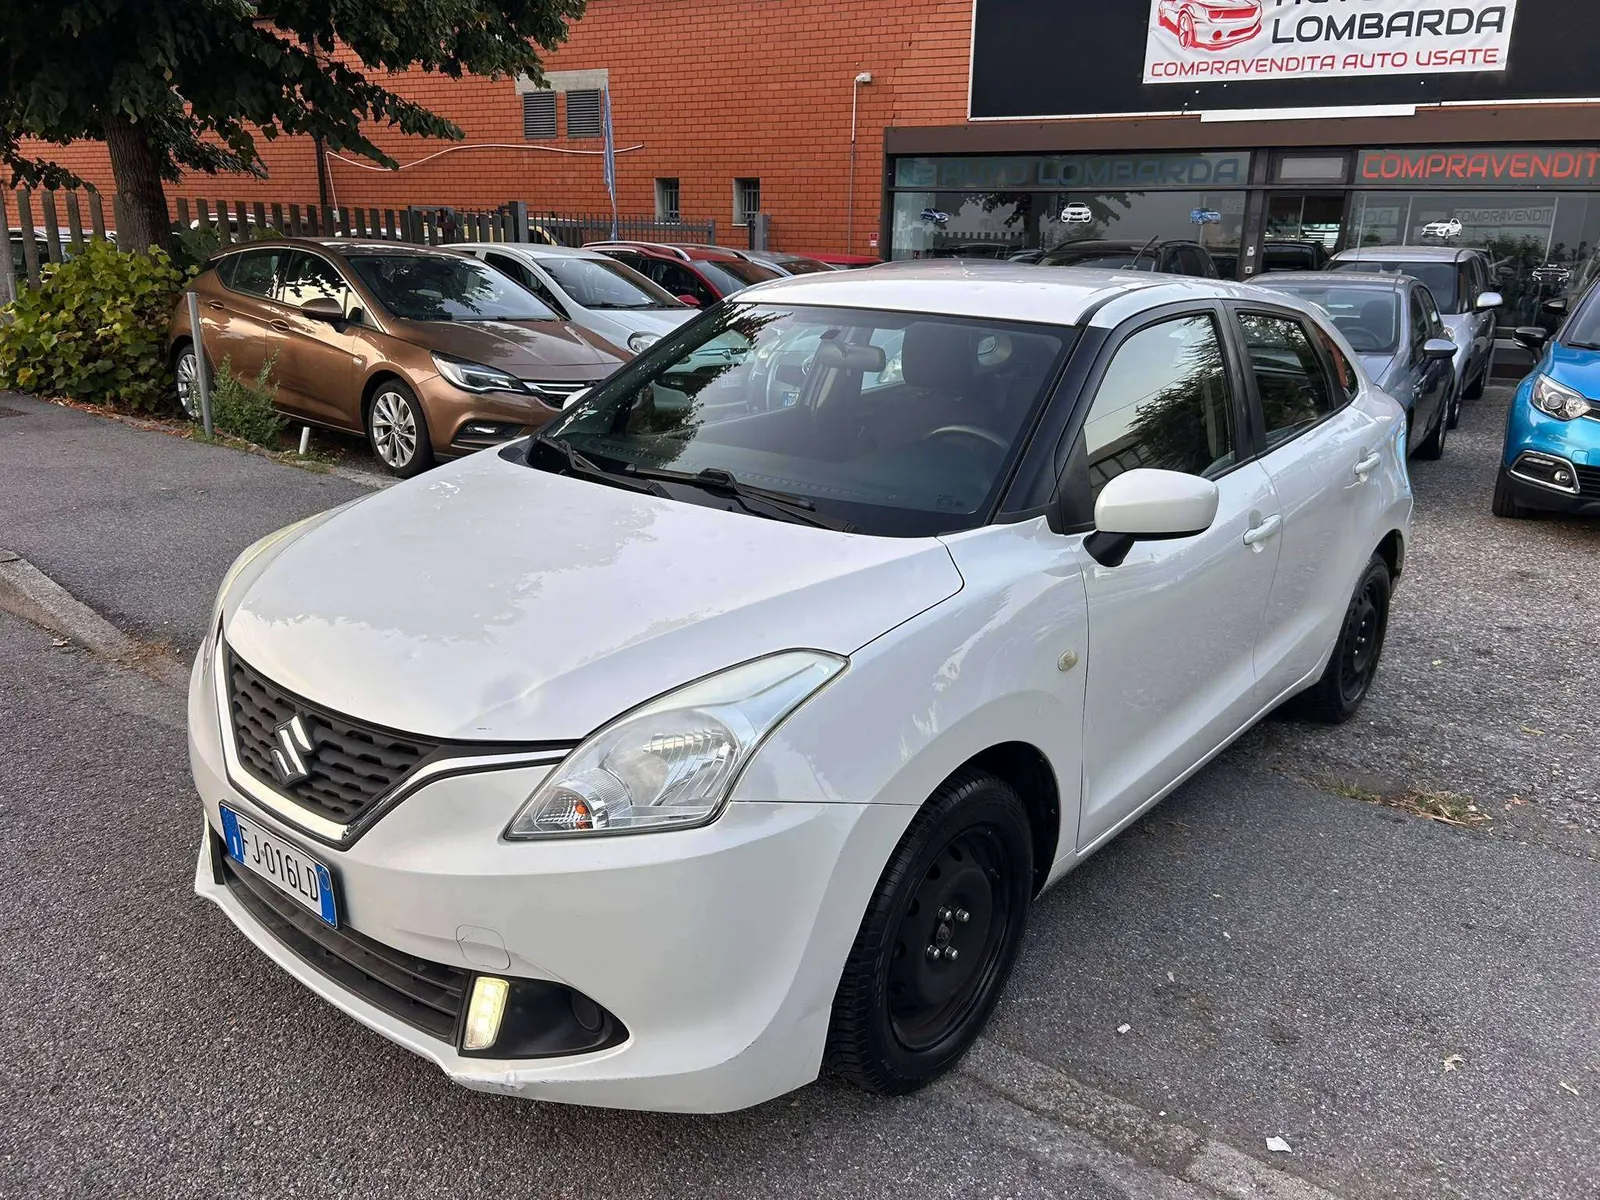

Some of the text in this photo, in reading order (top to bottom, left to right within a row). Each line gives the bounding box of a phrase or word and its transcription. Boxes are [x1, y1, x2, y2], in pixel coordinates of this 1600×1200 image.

[1272, 6, 1506, 44] LOMBARDA
[1151, 48, 1499, 77] COMPRAVENDITA AUTO USATE
[940, 157, 1239, 185] AUTO LOMBARDA
[1361, 152, 1600, 179] COMPRAVENDIT
